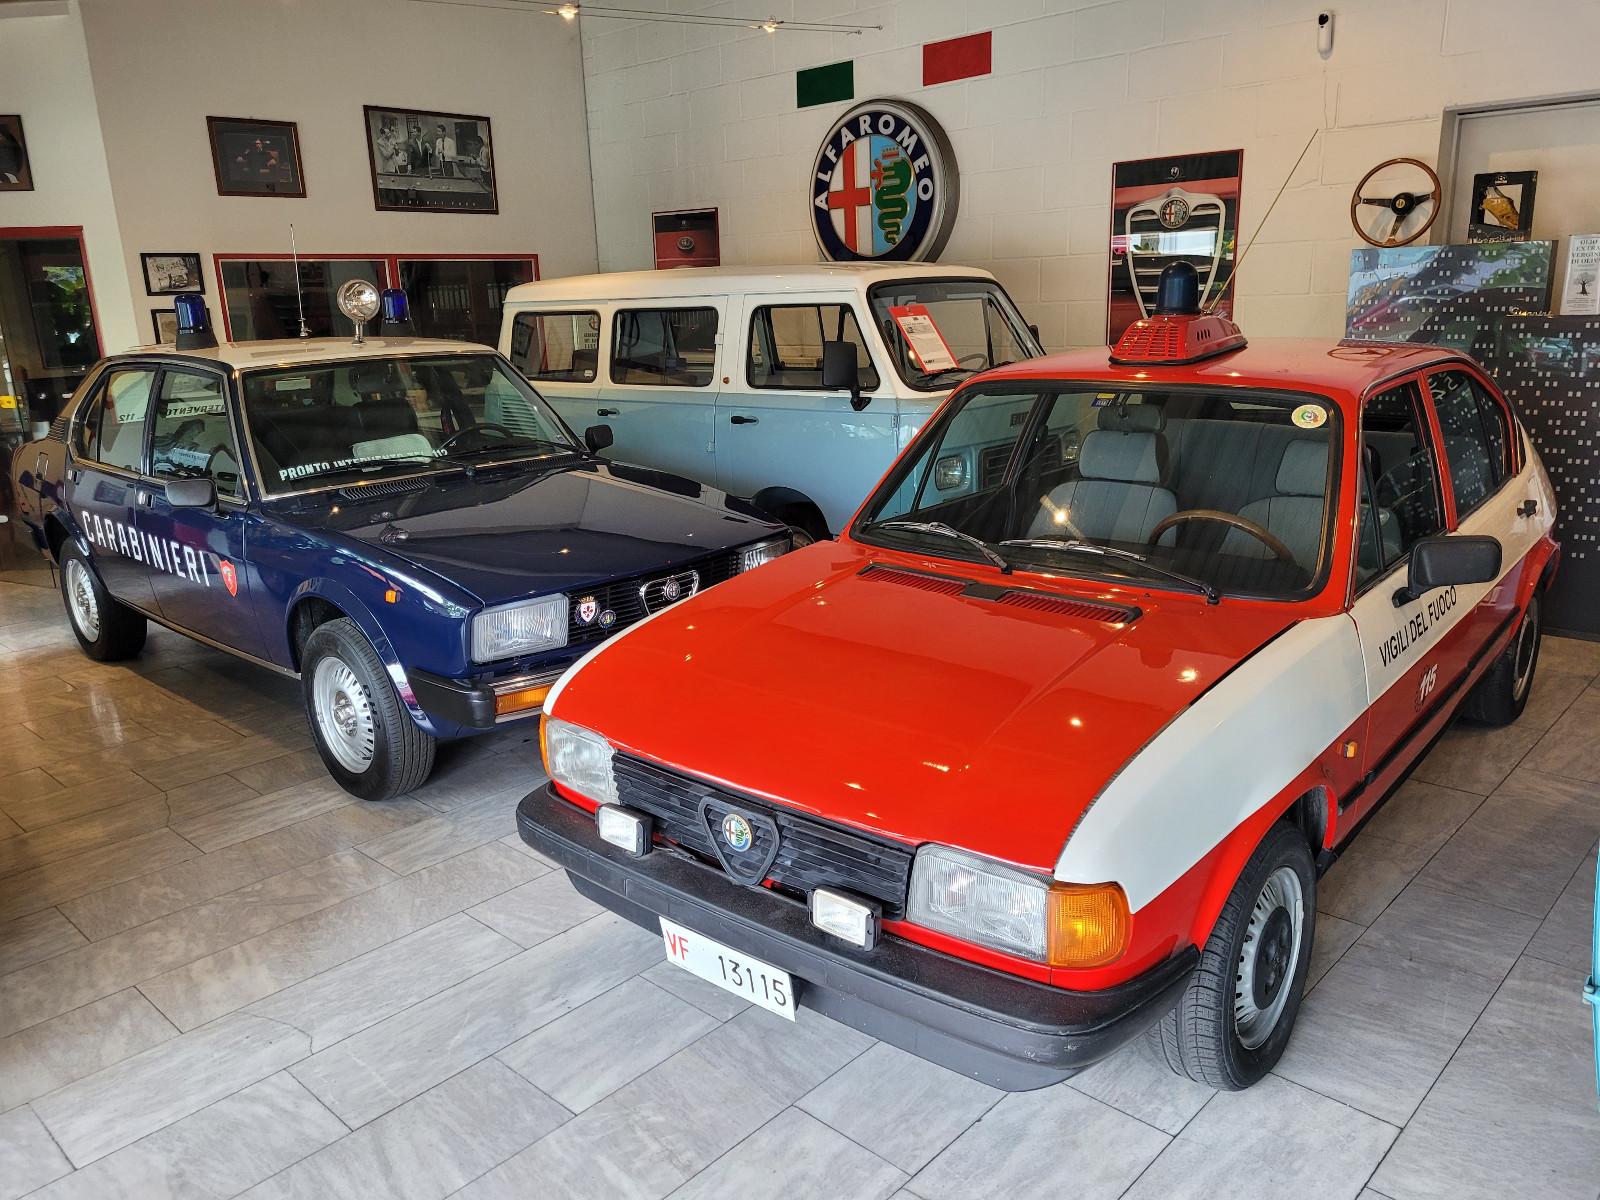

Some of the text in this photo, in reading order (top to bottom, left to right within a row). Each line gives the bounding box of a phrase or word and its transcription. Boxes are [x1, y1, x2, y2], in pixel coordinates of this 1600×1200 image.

[279, 462, 330, 481] PRONTO
[82, 510, 210, 587] CARABINIERI
[1378, 585, 1457, 668] VIGILI DEL FUOCO
[1419, 663, 1438, 702] 115
[666, 929, 787, 1007] VF 13115
